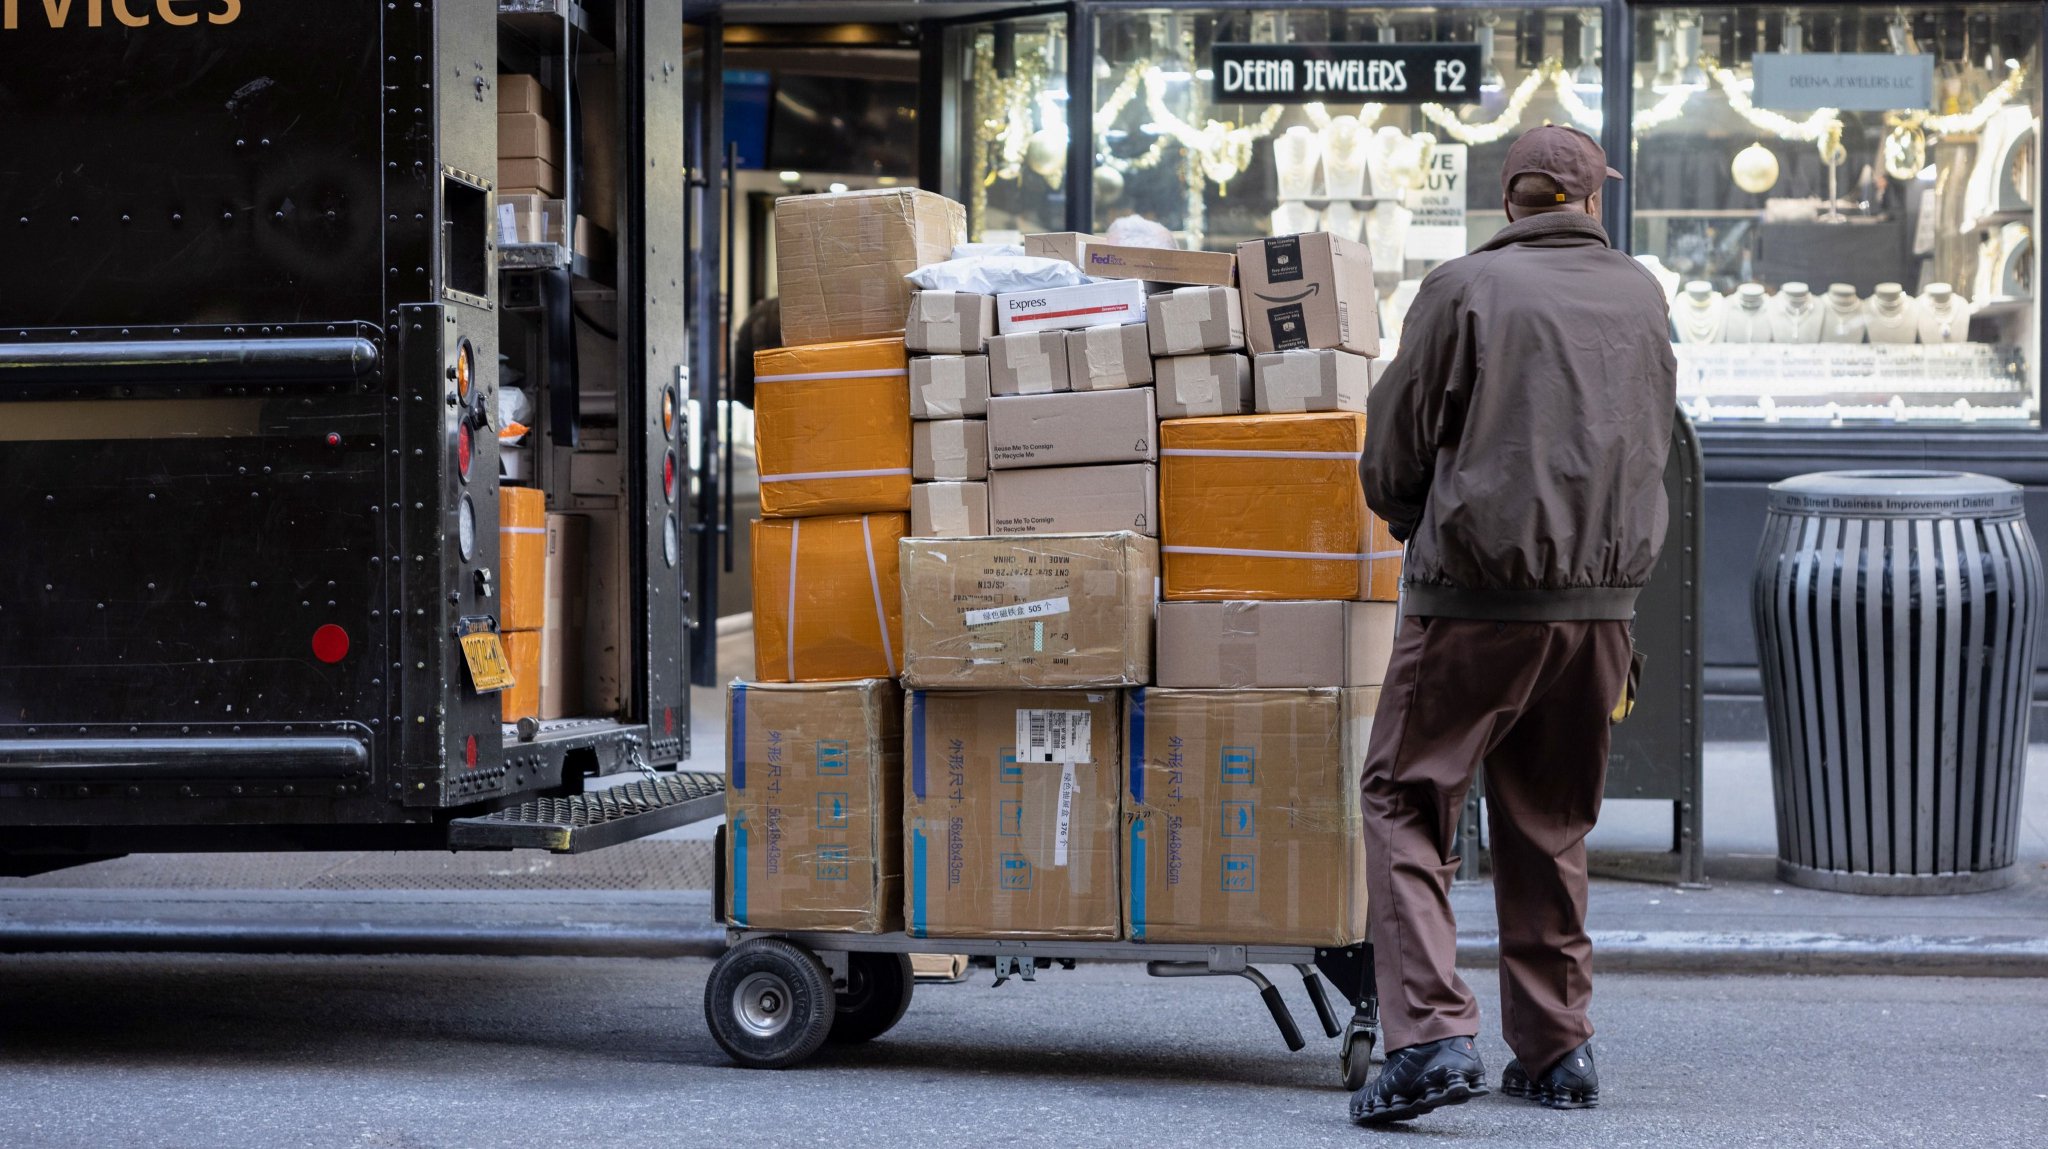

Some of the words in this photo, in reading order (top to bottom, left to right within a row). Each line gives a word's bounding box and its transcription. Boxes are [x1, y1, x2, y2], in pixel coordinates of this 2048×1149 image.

[1223, 60, 1295, 91] DEENA
[1303, 60, 1408, 91] JEWELERS
[1434, 60, 1467, 91] E2
[1789, 75, 1831, 88] DEENA
[1833, 75, 1890, 88] JEWELERS
[1893, 75, 1914, 88] LLC
[1091, 252, 1123, 266] FedEx
[1009, 298, 1047, 311] Express
[1804, 496, 1830, 508] Street
[1833, 498, 1883, 509] Business
[1886, 499, 1960, 510] Improvement
[1963, 497, 1994, 508] District
[994, 556, 1016, 564] CHINA
[1028, 556, 1036, 564] IN
[1049, 556, 1070, 564] MADE
[1028, 604, 1042, 614] 505
[1060, 821, 1068, 836] 376
[950, 816, 964, 884] 56x48x43cm
[1169, 816, 1182, 885] 56x48x43cm
